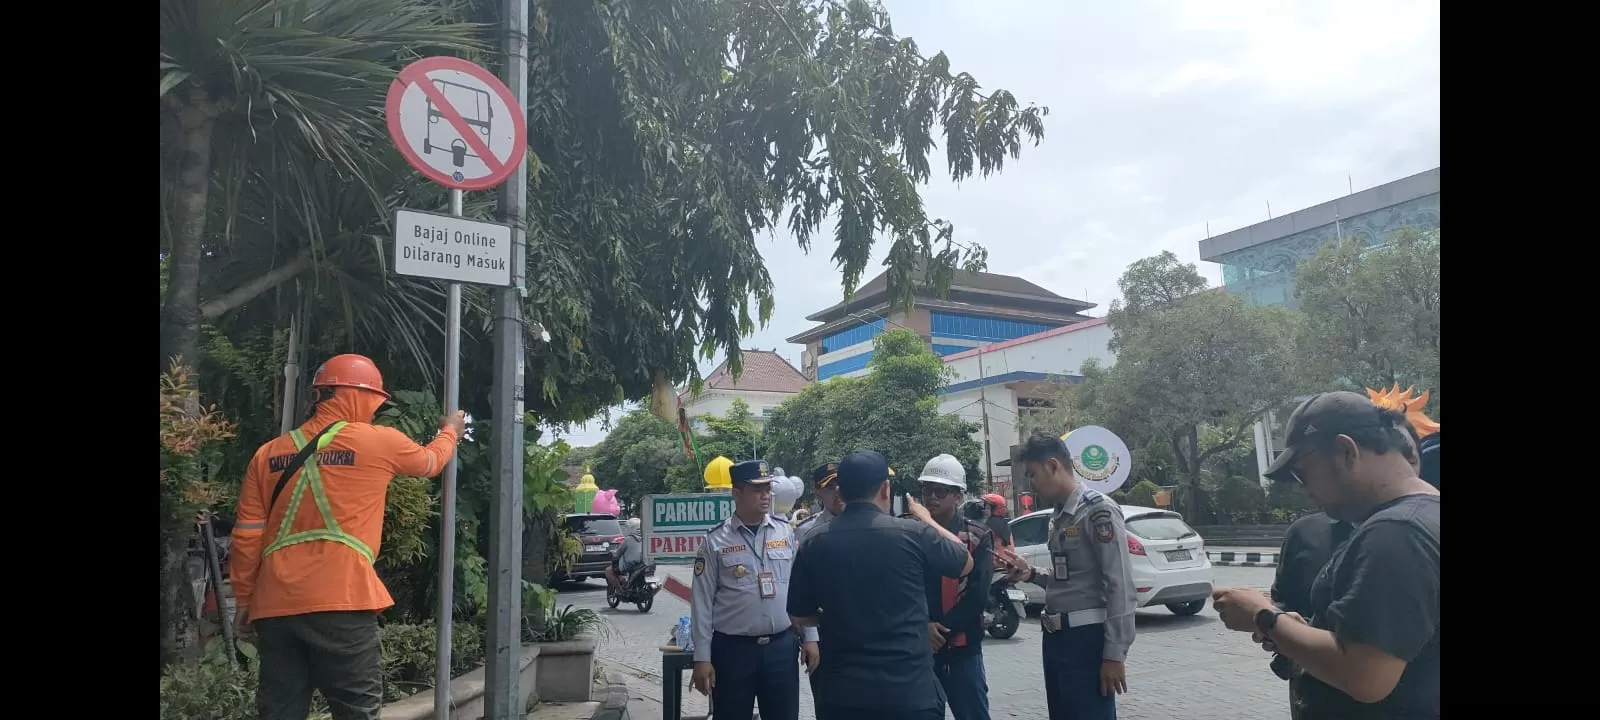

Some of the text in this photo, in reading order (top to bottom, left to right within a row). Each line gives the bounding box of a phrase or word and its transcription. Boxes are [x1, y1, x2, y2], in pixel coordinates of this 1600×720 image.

[414, 225, 496, 248] Bajaj Online
[403, 246, 505, 271] Dilarang Masuk
[655, 501, 716, 522] PARKIR
